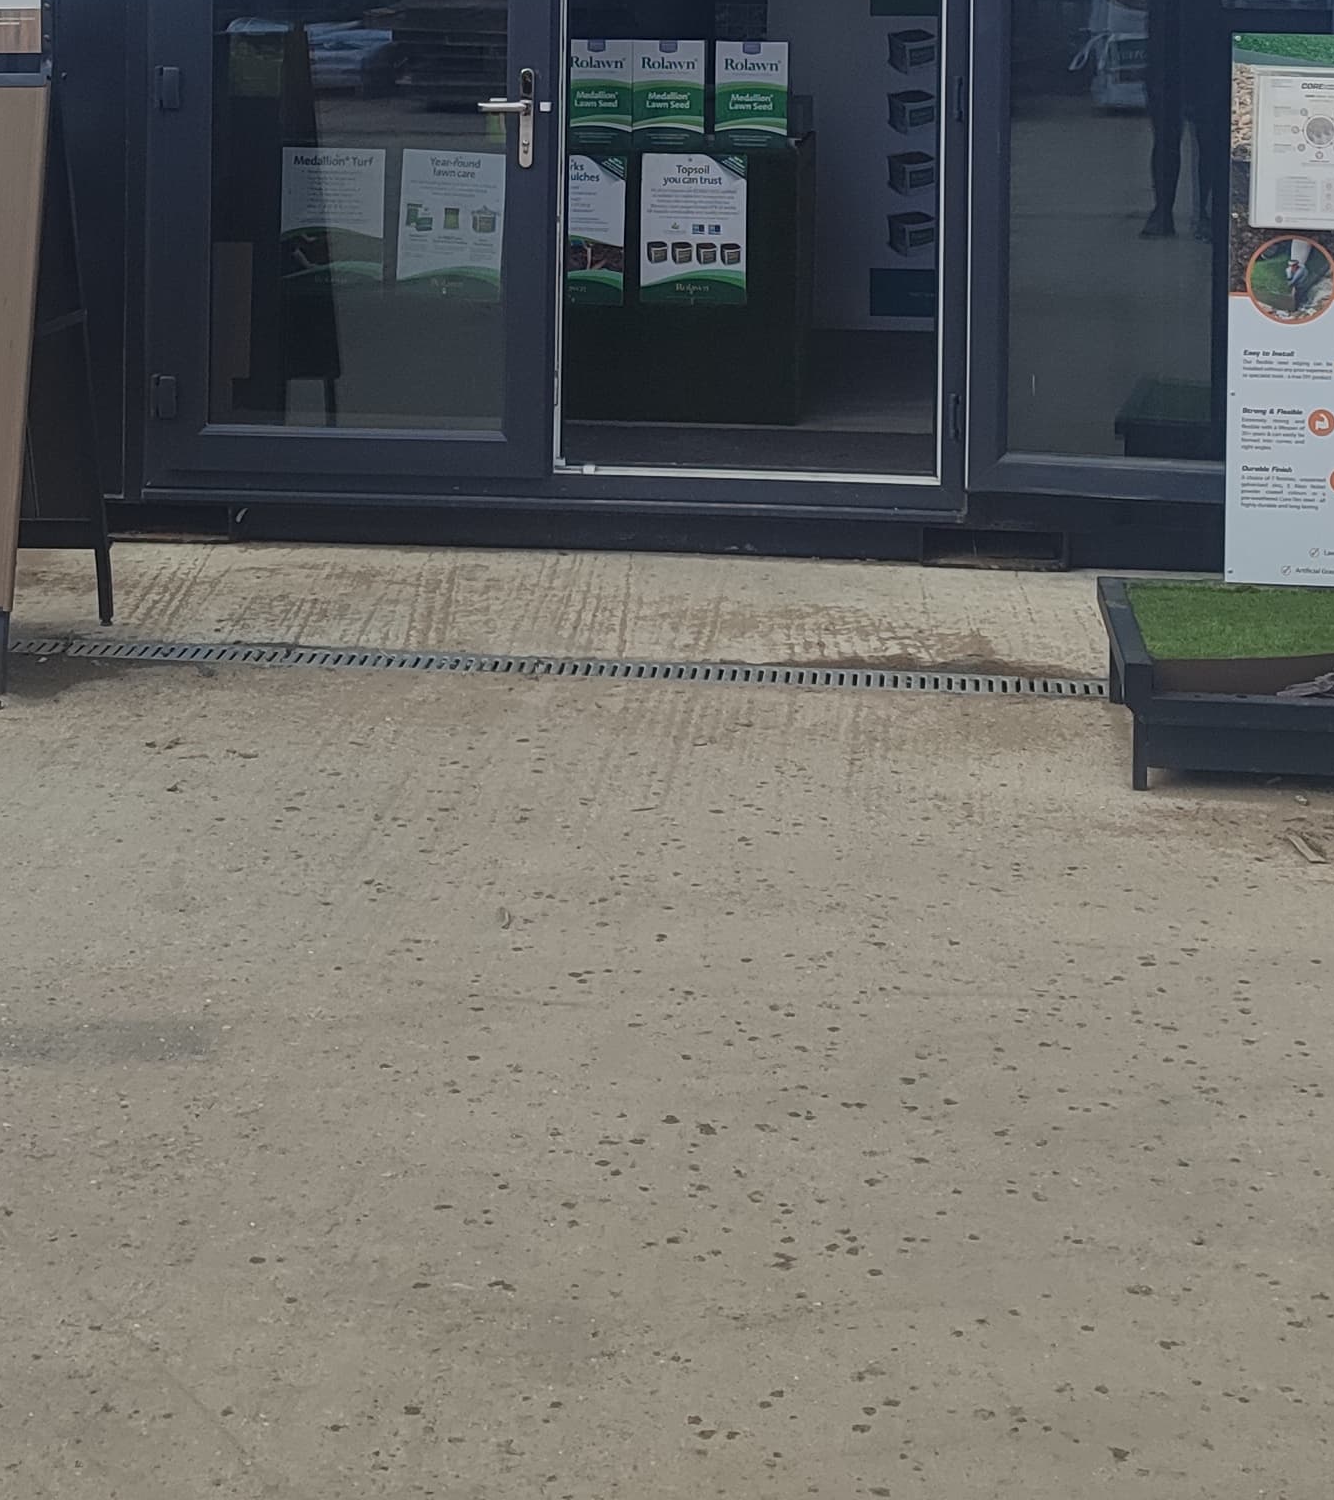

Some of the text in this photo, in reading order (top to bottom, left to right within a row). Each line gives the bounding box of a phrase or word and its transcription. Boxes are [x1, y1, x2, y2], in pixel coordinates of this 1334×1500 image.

[574, 99, 618, 108] Lawn Seed
[646, 101, 690, 109] Lawn Seed
[729, 102, 773, 111] Lawn Seed
[351, 156, 374, 168] Turf
[430, 156, 481, 168] Year-round
[457, 170, 476, 179] care
[676, 165, 710, 175] Topsoil
[571, 173, 600, 182] ulches
[663, 176, 722, 186] you can trust
